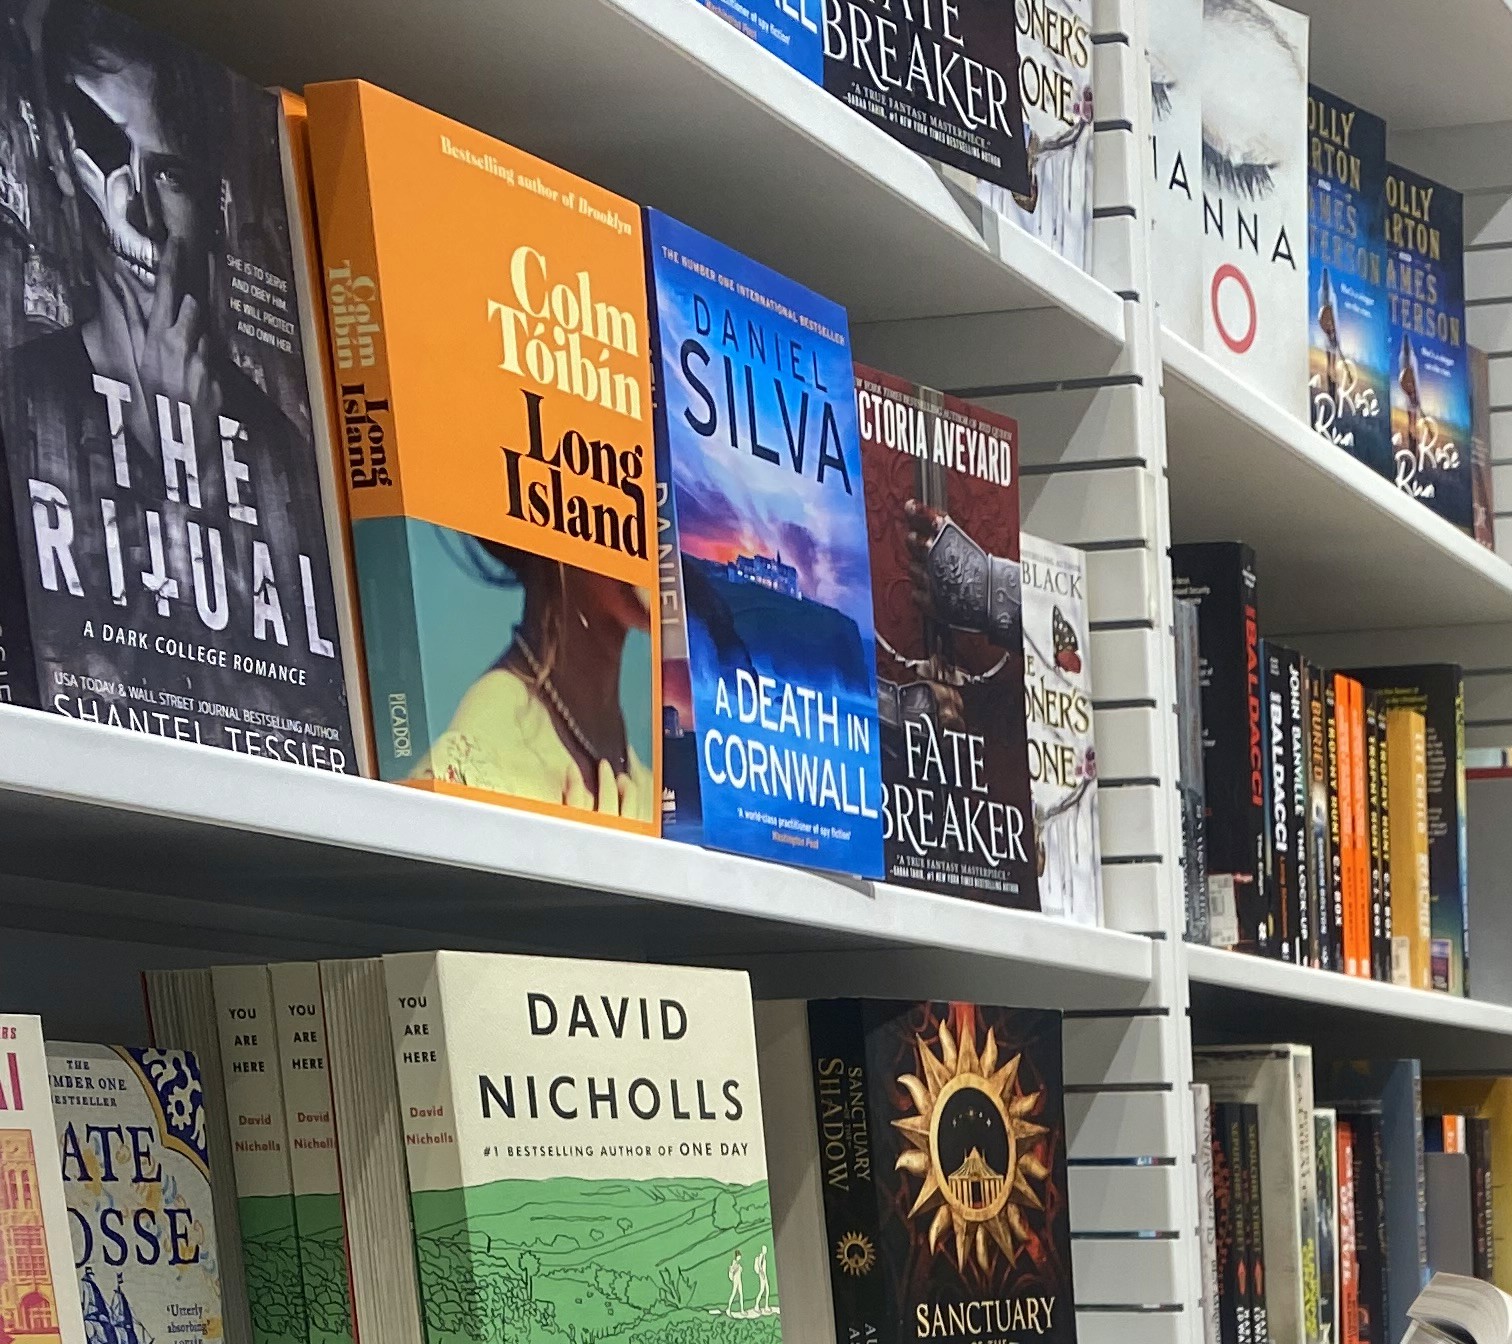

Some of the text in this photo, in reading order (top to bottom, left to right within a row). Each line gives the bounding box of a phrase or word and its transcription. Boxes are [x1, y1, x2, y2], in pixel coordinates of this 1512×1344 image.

[823, 0, 1013, 138] BREAKER
[439, 134, 632, 236] Bestselling author of Brooklyn
[1202, 196, 1296, 270] NNA
[509, 245, 638, 357] Colm
[661, 245, 846, 346] THE NUMBER ONE INTERNATIONAL BESTSELLER
[1209, 262, 1257, 354] O
[487, 298, 643, 422] Tóibín
[693, 293, 829, 394] DANIEL
[92, 373, 259, 526] THE
[520, 388, 644, 493] Long
[678, 338, 853, 496] SILVA
[854, 389, 1012, 488] CTORIA AVEYARD
[1418, 417, 1460, 471] Rose
[499, 446, 649, 562] Island
[1394, 450, 1436, 500] Run
[27, 478, 336, 658] RITUAL
[83, 620, 307, 686] A DARK COLLEGE ROMANCE
[1287, 662, 1302, 721] JOHN
[53, 671, 340, 740] USA TODAY & WALL STREET JOURNAL BESTSELLING AUTHOR
[388, 692, 411, 759] PICADOR
[714, 669, 870, 755] A DEATH IN
[1311, 700, 1324, 781] BURIED
[703, 726, 880, 821] CORNWALL
[904, 712, 990, 796] FATE
[1269, 702, 1288, 853] BALDACCI
[525, 991, 690, 1042] DAVID
[98, 1076, 128, 1092] ONE
[477, 1073, 745, 1123] NICHOLLS
[482, 1139, 751, 1159] #1 BESTSELLING AUTHOR OF ONE DAY
[915, 1296, 1057, 1339] SANCTUARY
